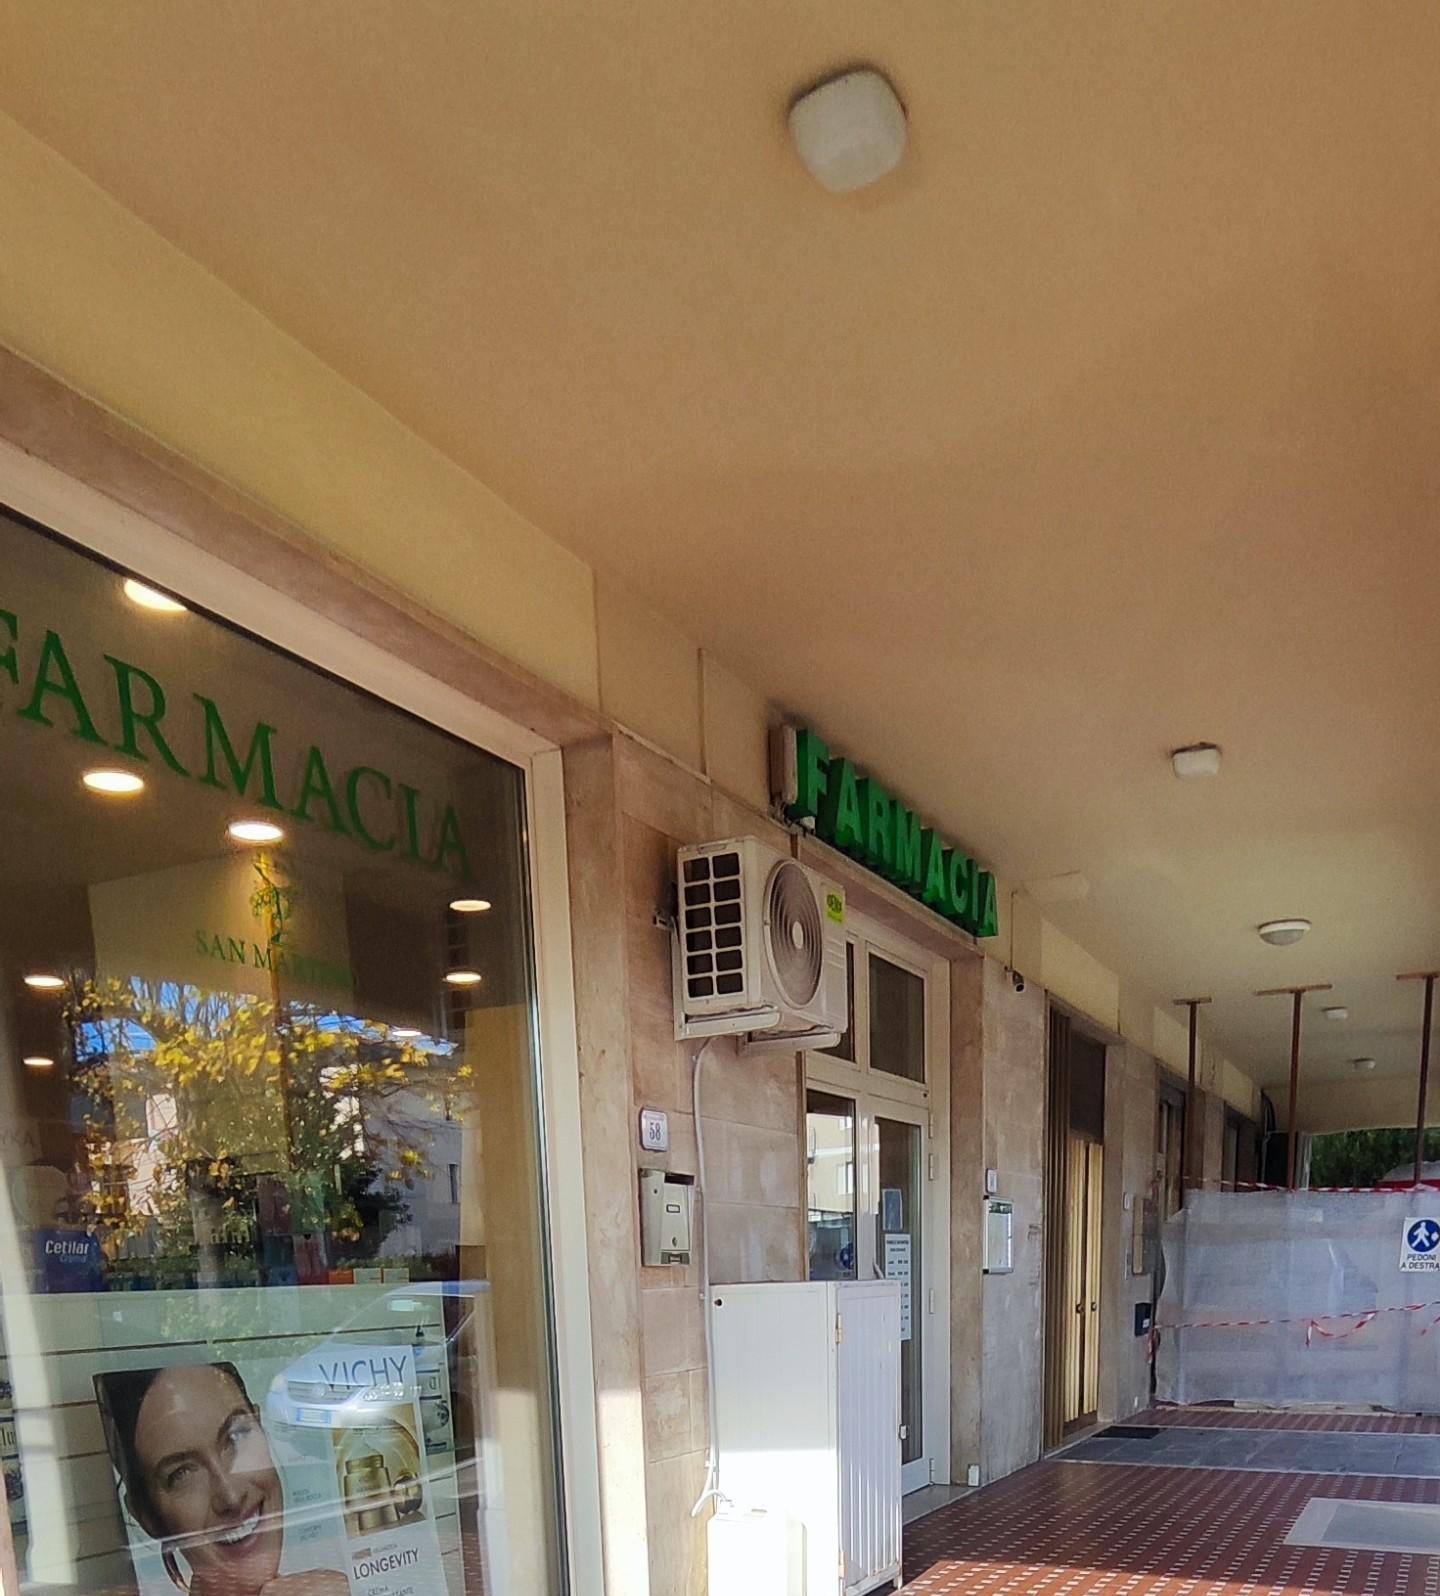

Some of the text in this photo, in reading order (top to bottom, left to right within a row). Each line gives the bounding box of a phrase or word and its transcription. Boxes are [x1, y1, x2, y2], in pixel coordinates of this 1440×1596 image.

[799, 729, 998, 937] FARMACIA
[196, 929, 246, 965] SAN
[649, 1122, 661, 1141] 58
[45, 1240, 89, 1255] Cetilar
[1408, 1261, 1440, 1269] DESTRA
[319, 1355, 407, 1391] VICHY
[353, 1548, 419, 1580] LONGEVITY
